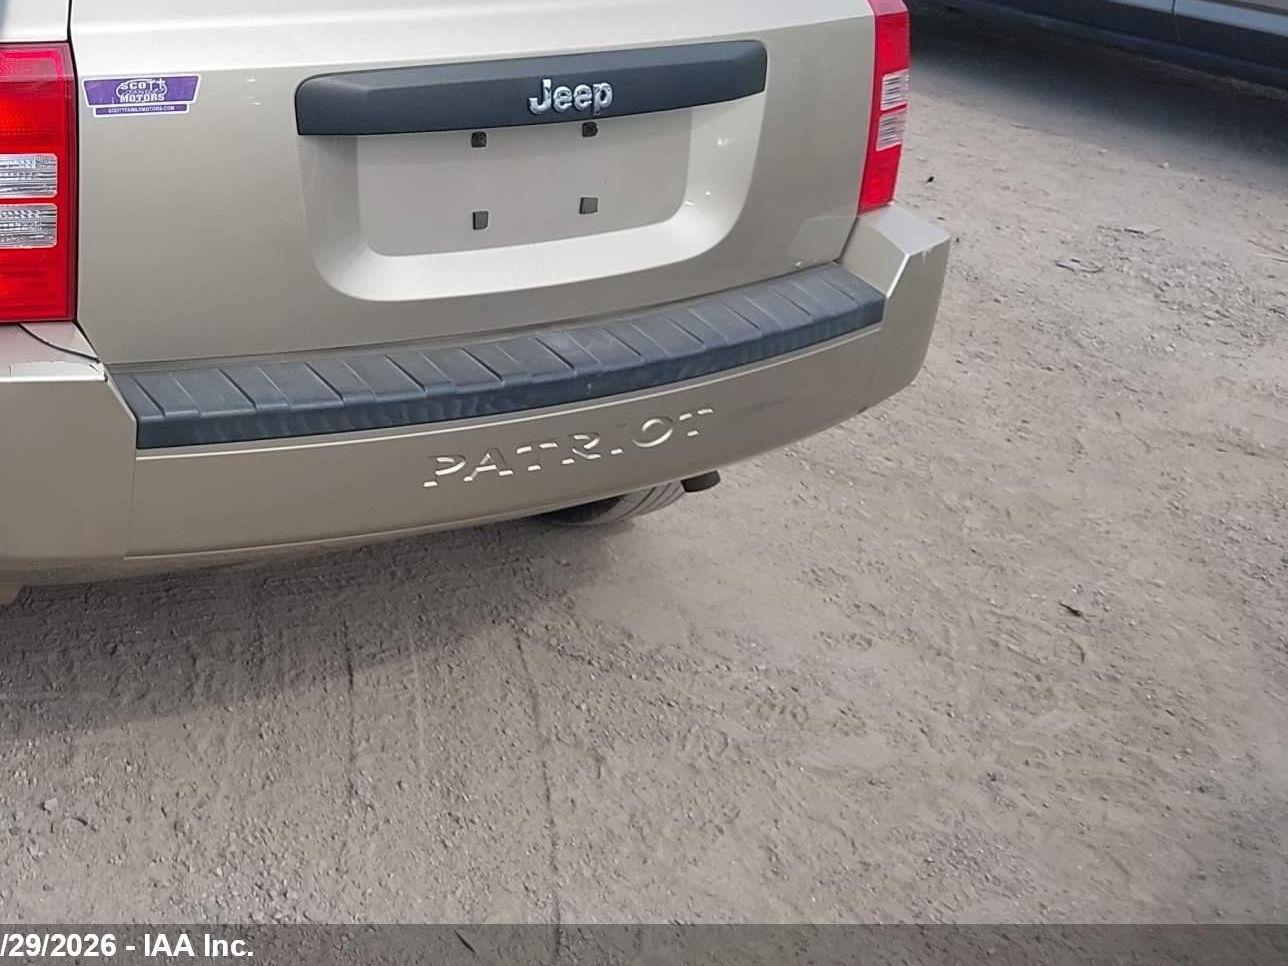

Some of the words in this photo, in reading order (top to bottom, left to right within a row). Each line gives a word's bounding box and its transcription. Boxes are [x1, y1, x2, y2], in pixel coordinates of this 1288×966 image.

[120, 78, 166, 91] SCOTT
[528, 78, 613, 115] Jeep
[120, 94, 165, 103] MOTORS
[422, 407, 714, 488] PATRIOT
